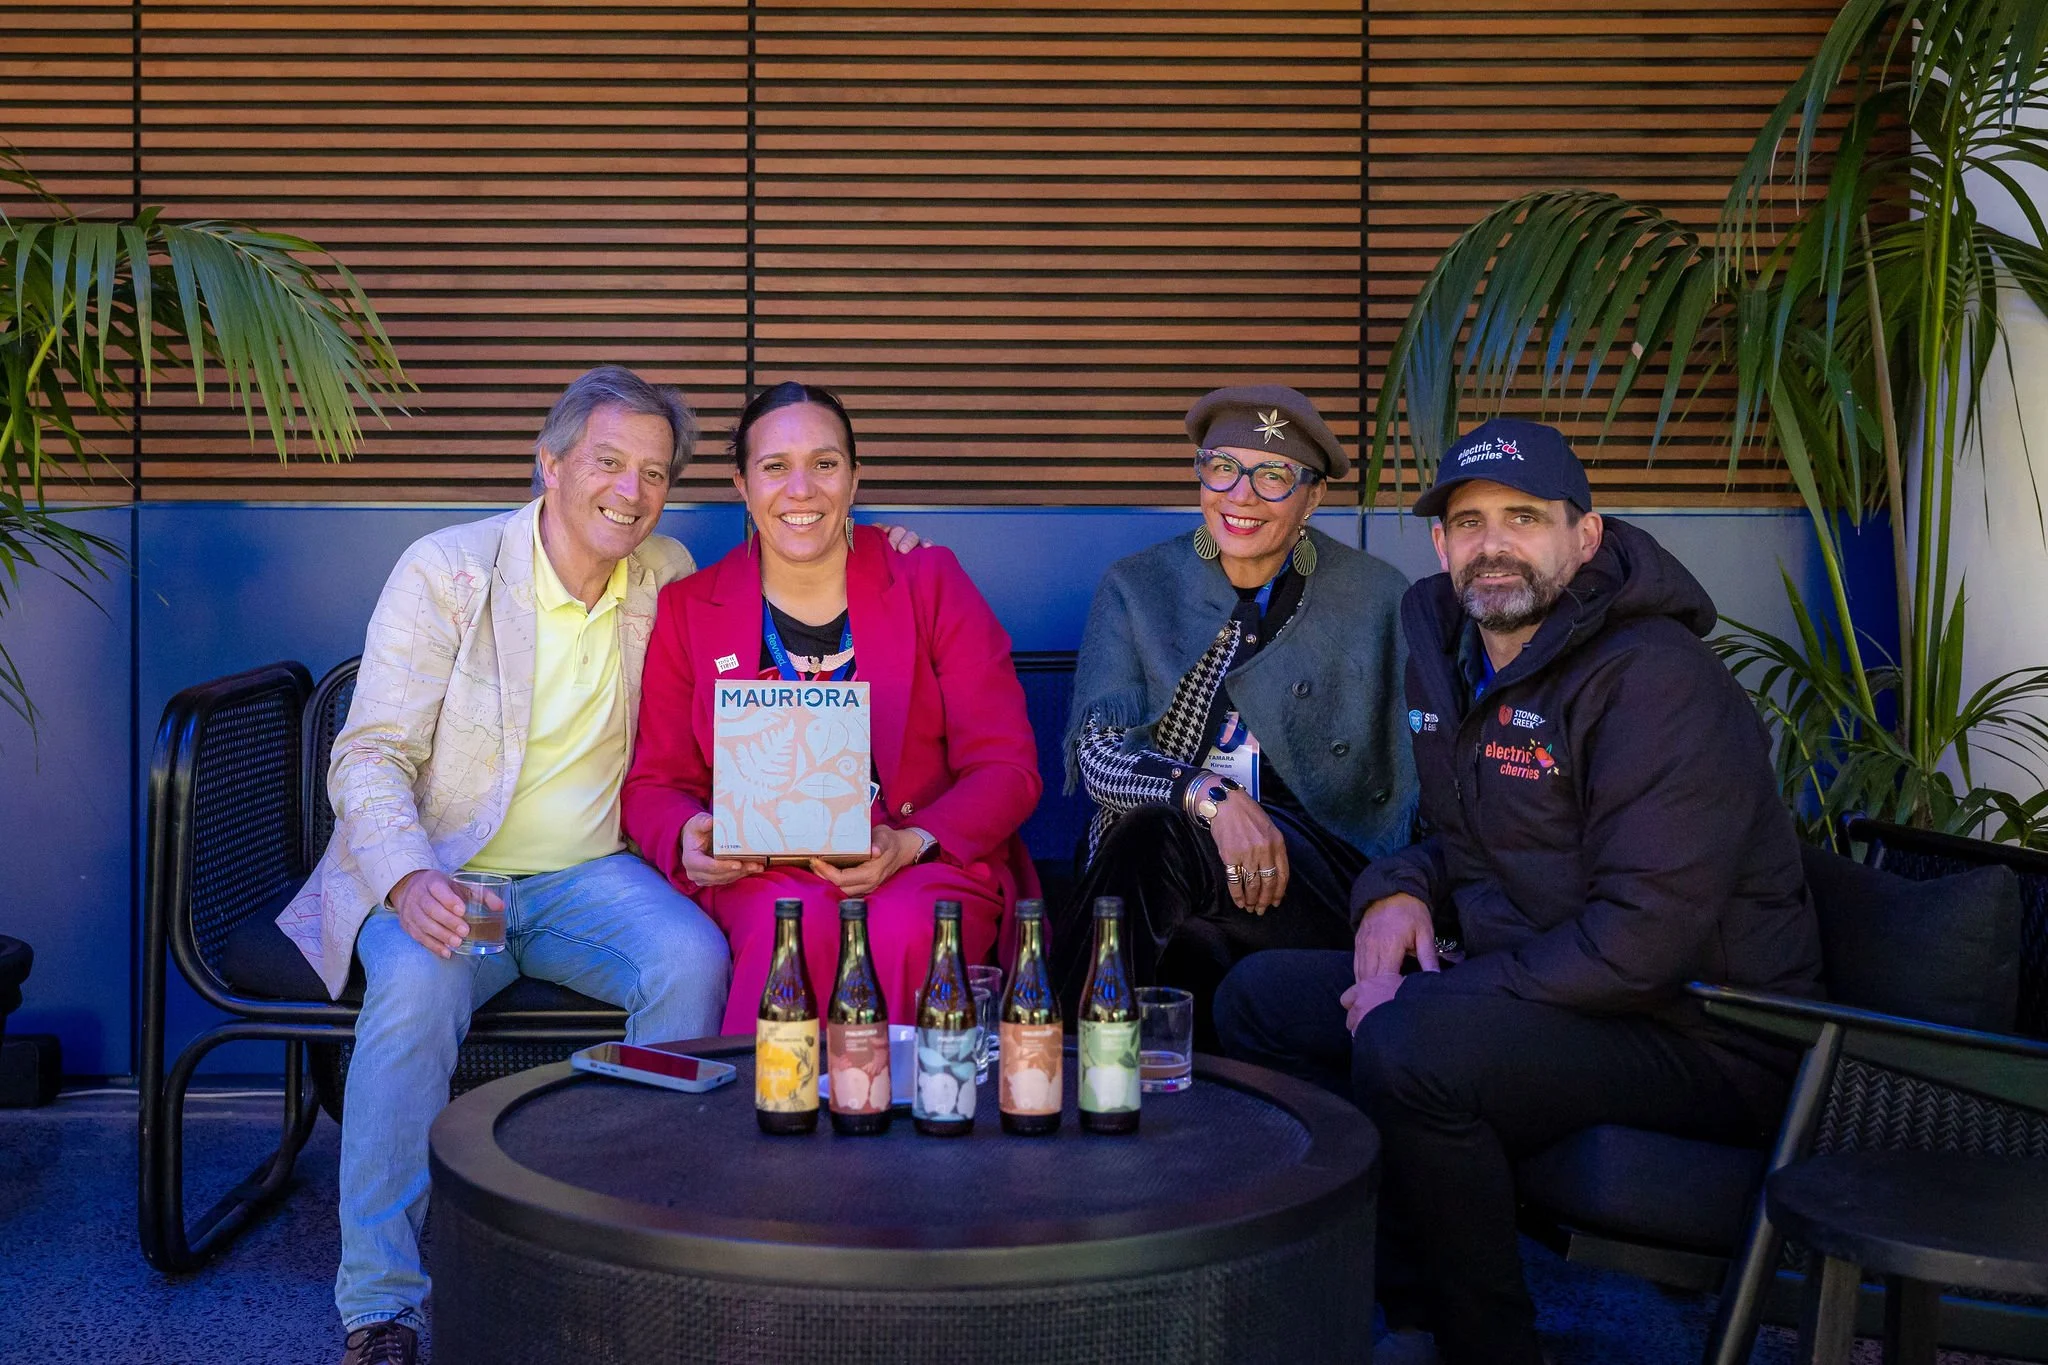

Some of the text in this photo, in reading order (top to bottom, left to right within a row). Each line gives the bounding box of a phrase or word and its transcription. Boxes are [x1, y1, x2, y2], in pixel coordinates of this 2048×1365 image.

[1458, 441, 1492, 460] electric
[1460, 451, 1502, 467] cherries
[721, 688, 860, 708] MAURIORA
[1513, 709, 1546, 724] STONEY
[1485, 741, 1533, 764] electric
[1500, 762, 1540, 780] cherries
